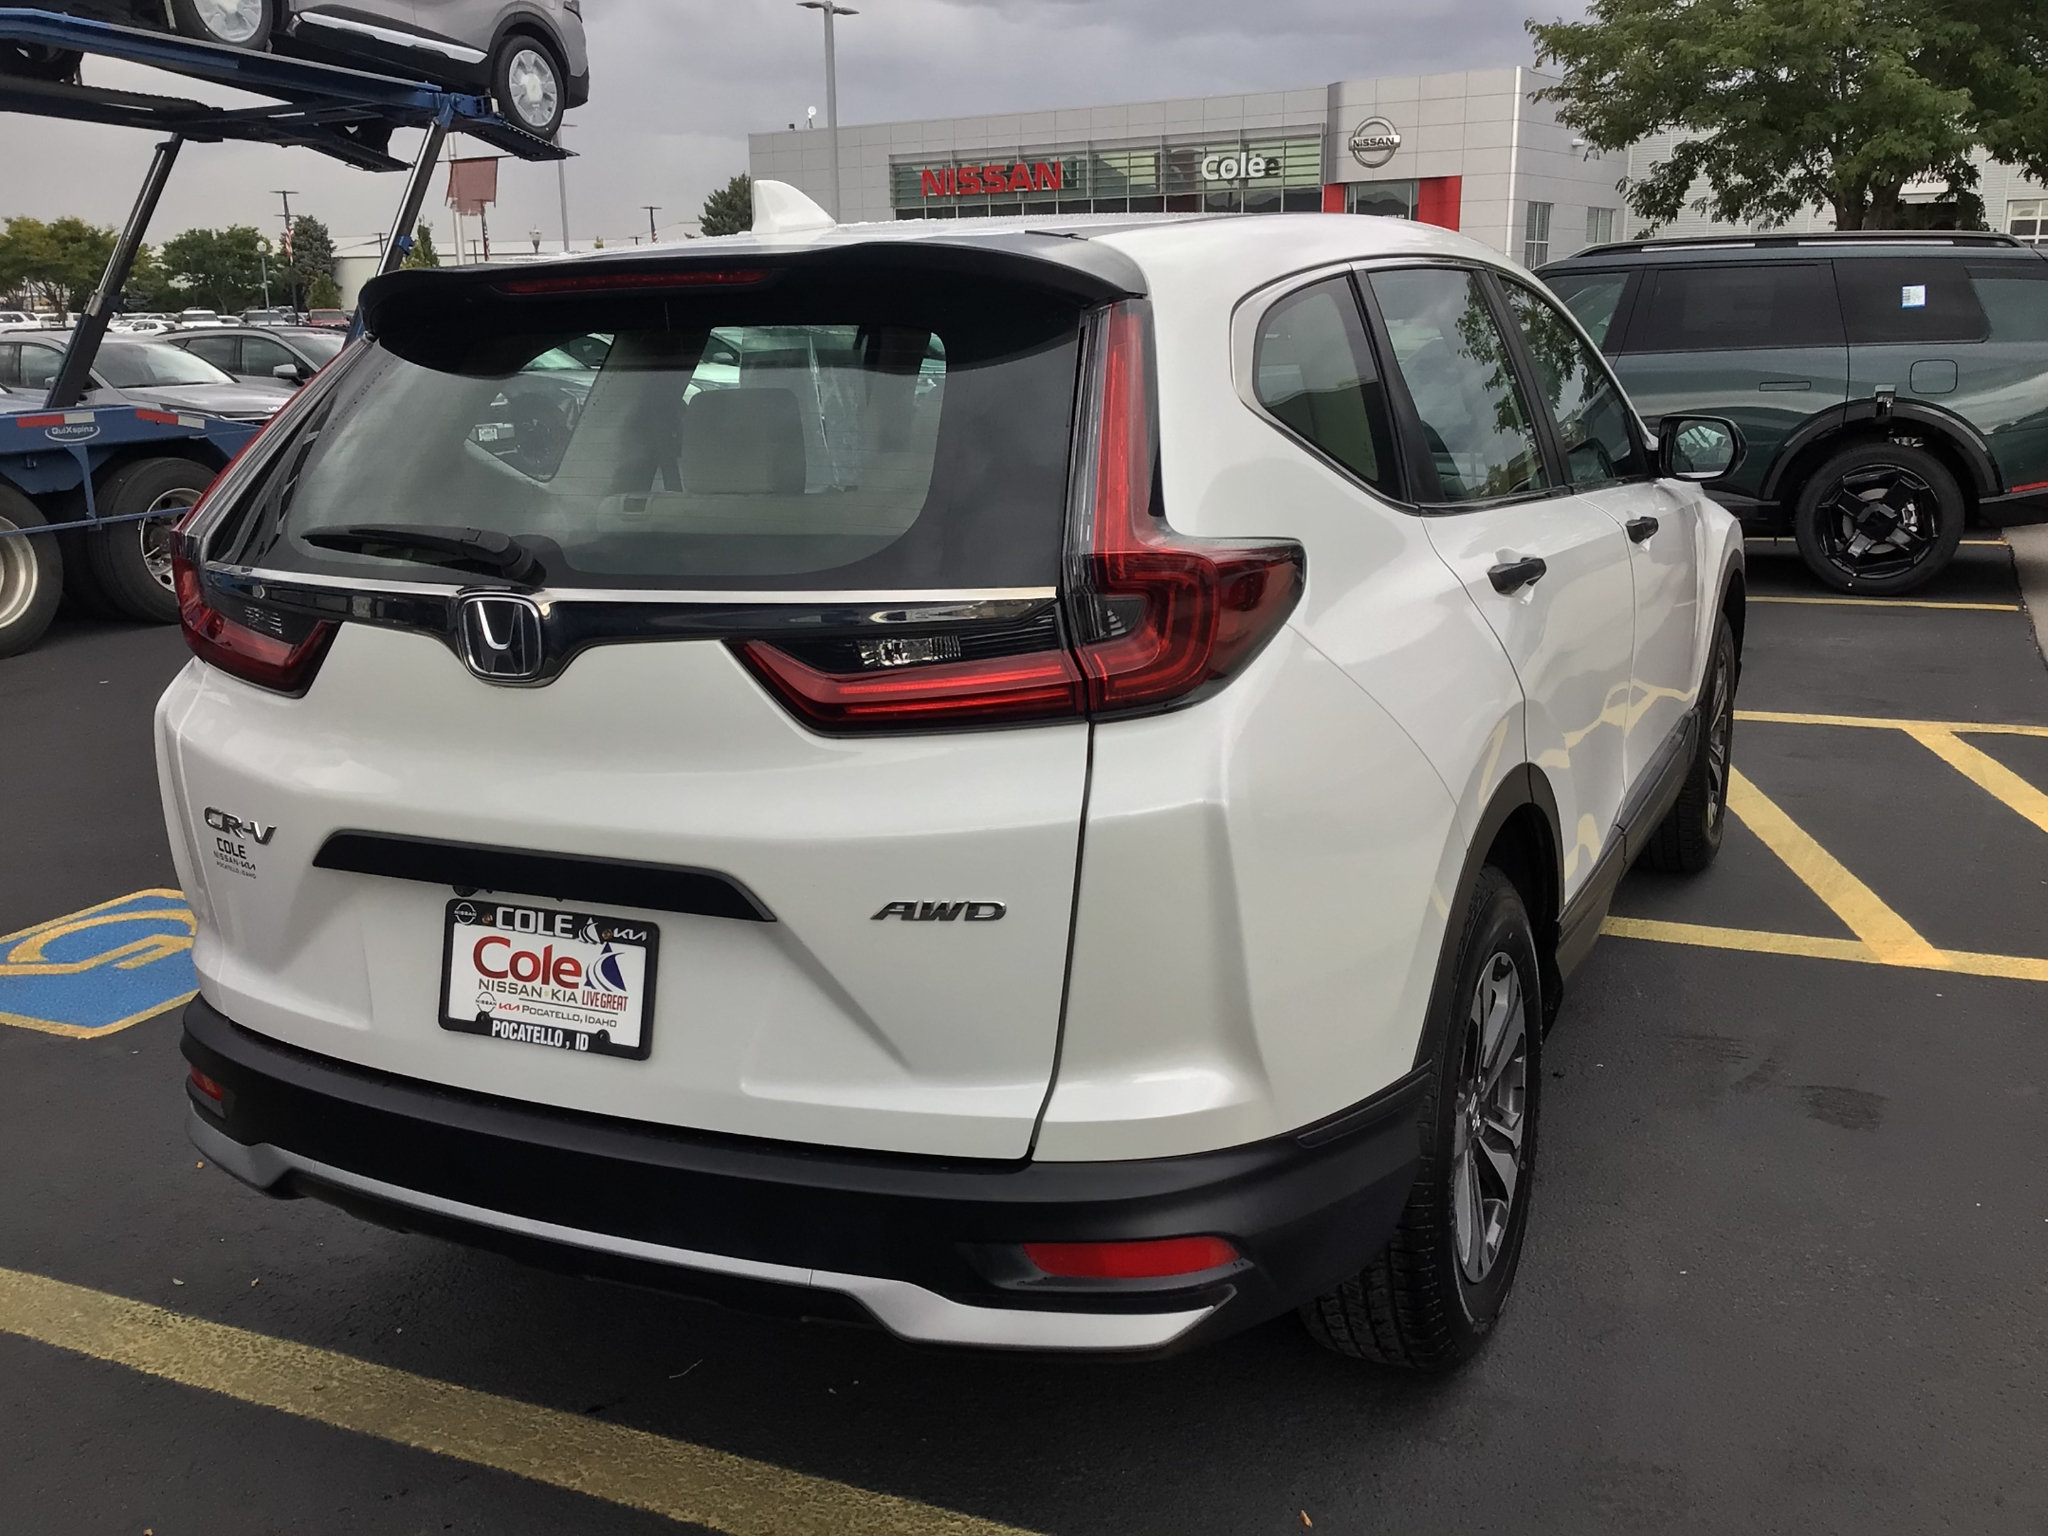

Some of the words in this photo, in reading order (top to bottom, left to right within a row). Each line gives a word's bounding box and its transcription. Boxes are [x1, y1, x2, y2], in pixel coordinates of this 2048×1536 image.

[1353, 136, 1395, 148] NISSAN
[922, 160, 1064, 197] NISSAN
[1201, 152, 1266, 180] Cole
[204, 806, 277, 846] CR-V
[216, 837, 246, 859] COLE
[496, 907, 573, 938] COLE
[869, 899, 1007, 921] AWD
[473, 936, 582, 989] Cole
[478, 978, 543, 999] NISSAN
[550, 988, 578, 1005] KIA
[584, 1014, 618, 1028] IDAHO
[574, 1033, 590, 1051] ID
